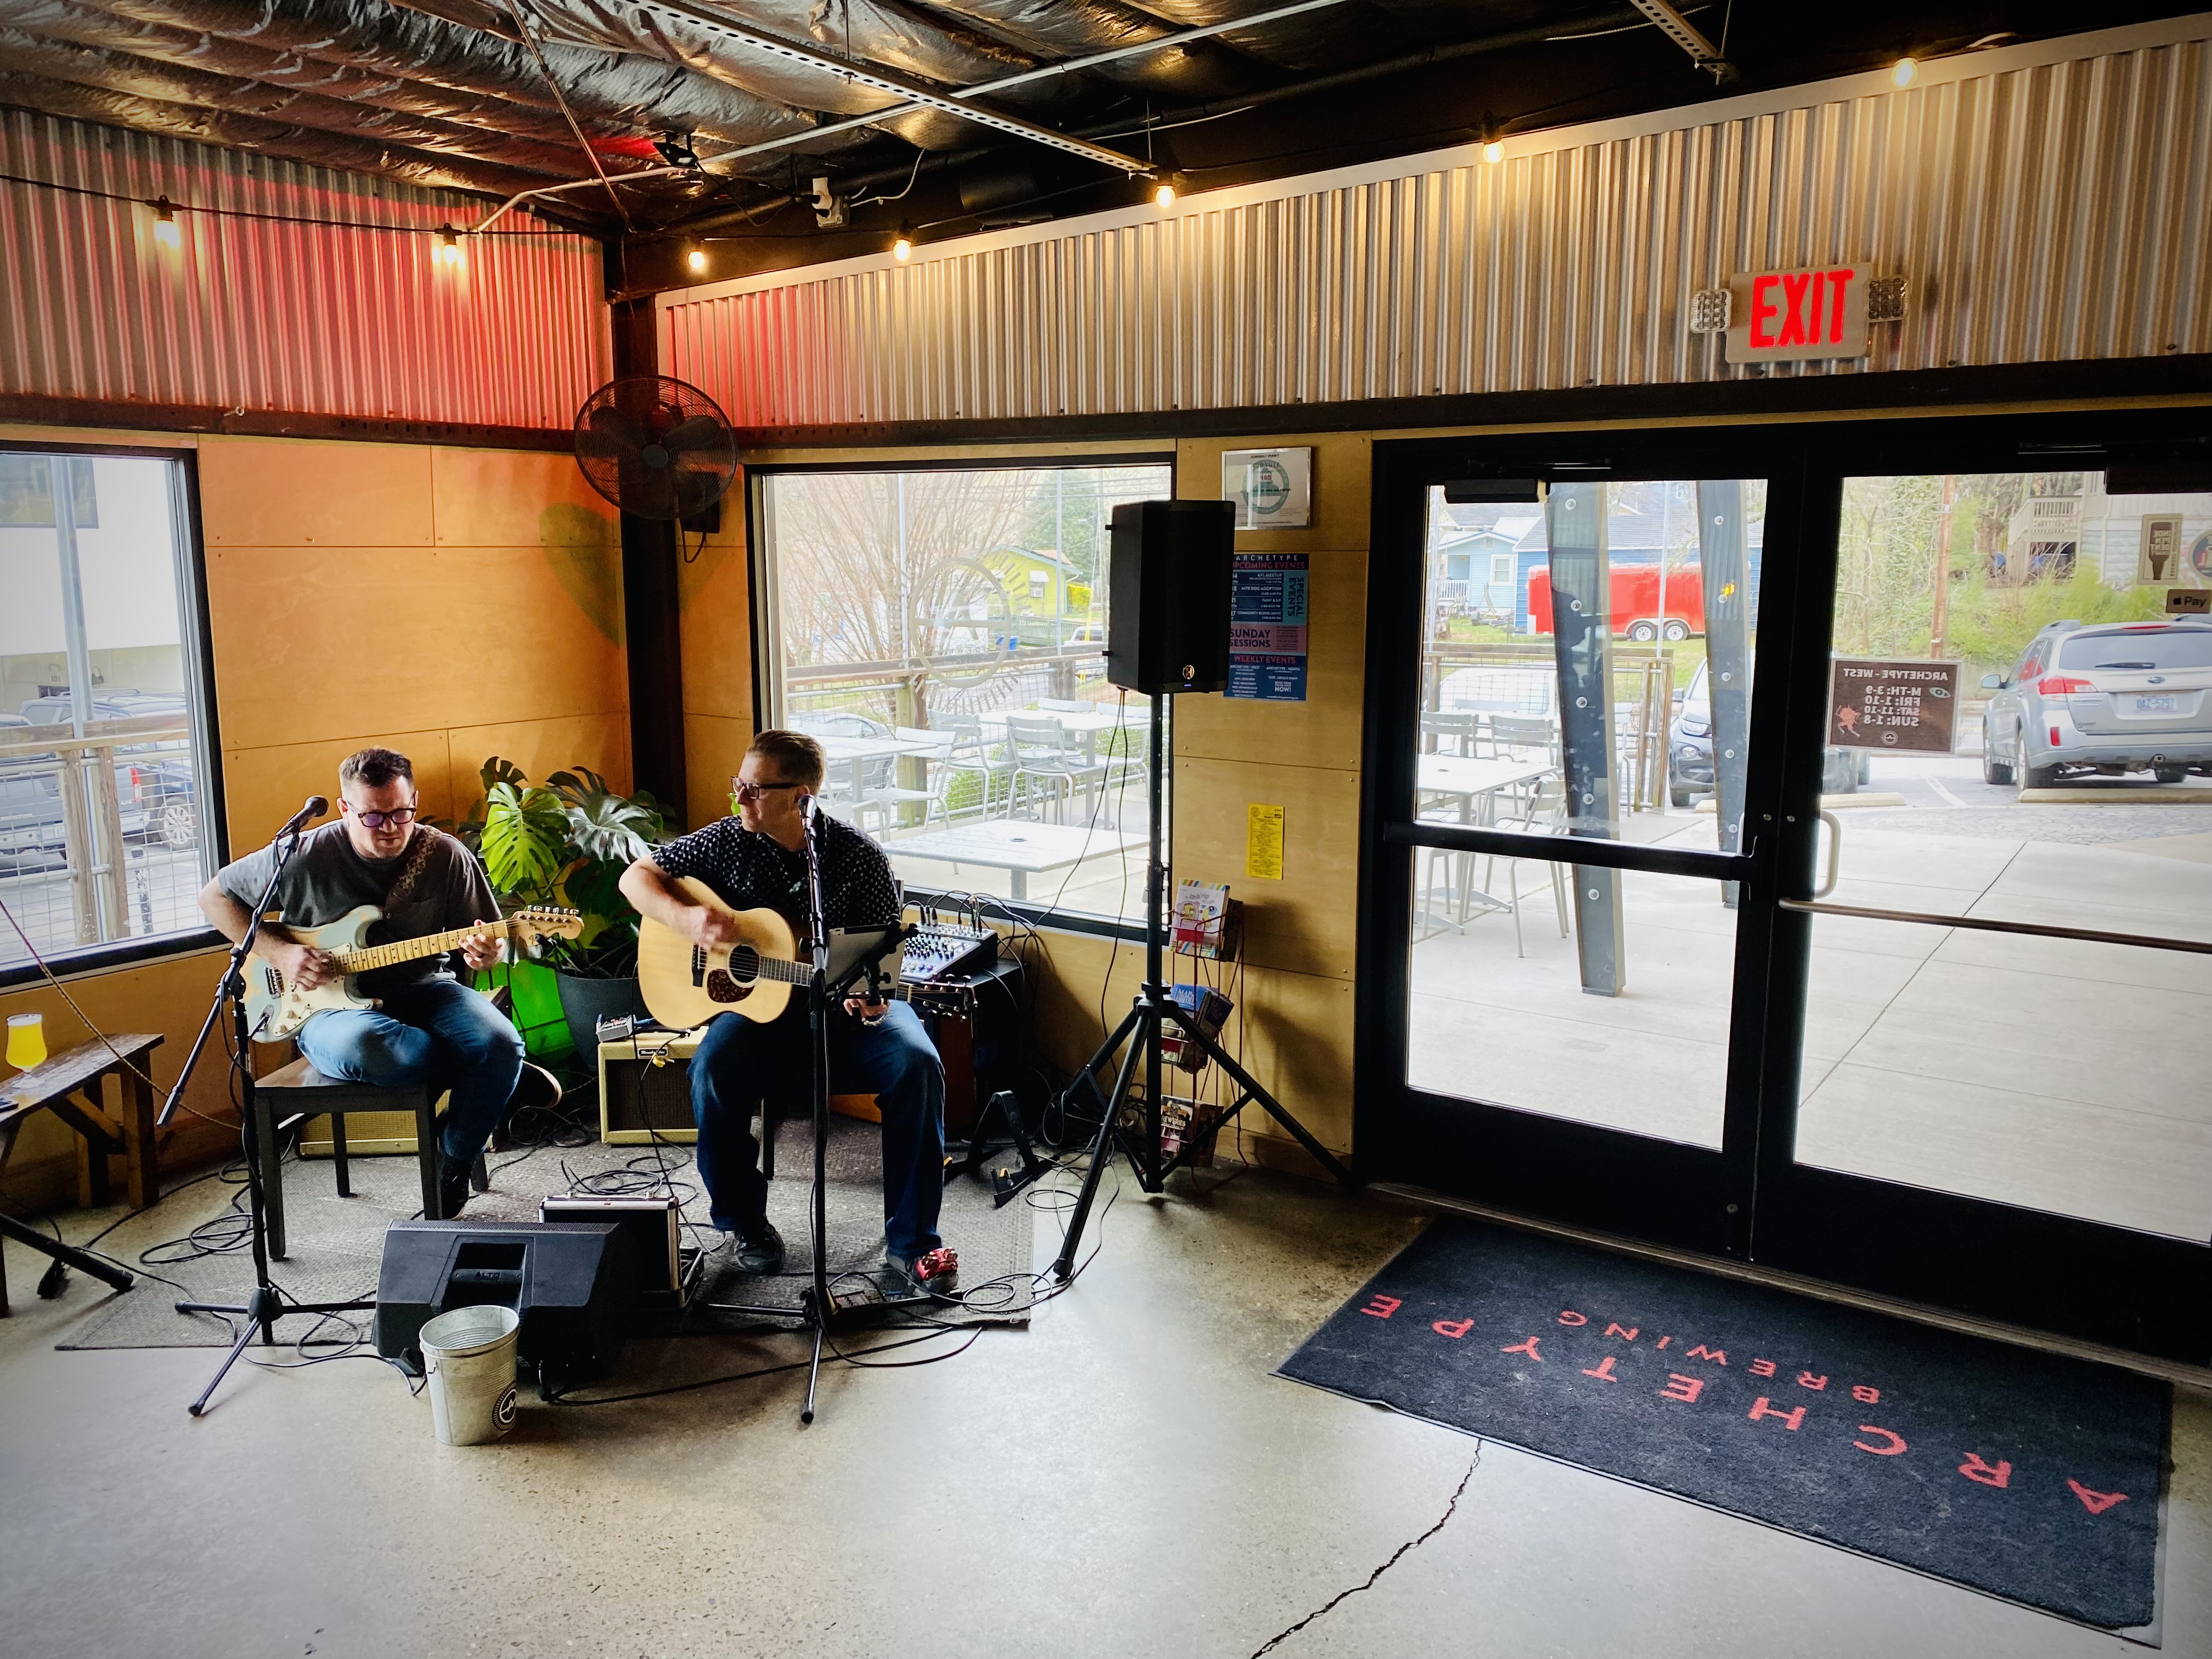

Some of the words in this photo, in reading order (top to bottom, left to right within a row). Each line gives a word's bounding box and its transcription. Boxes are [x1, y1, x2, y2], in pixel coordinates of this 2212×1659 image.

[1750, 269, 1854, 349] EXIT
[1288, 577, 1296, 617] EVENTS
[1296, 577, 1304, 617] SPECIAL
[2184, 596, 2207, 608] Pay
[1229, 629, 1271, 639] SUNDAY
[1229, 639, 1271, 647] SESSIONS
[1266, 656, 1296, 664] EVENTS
[474, 1271, 500, 1279] ALTO
[1558, 1310, 1880, 1404] BREWING
[1361, 1294, 2126, 1514] ARCHETYPE
